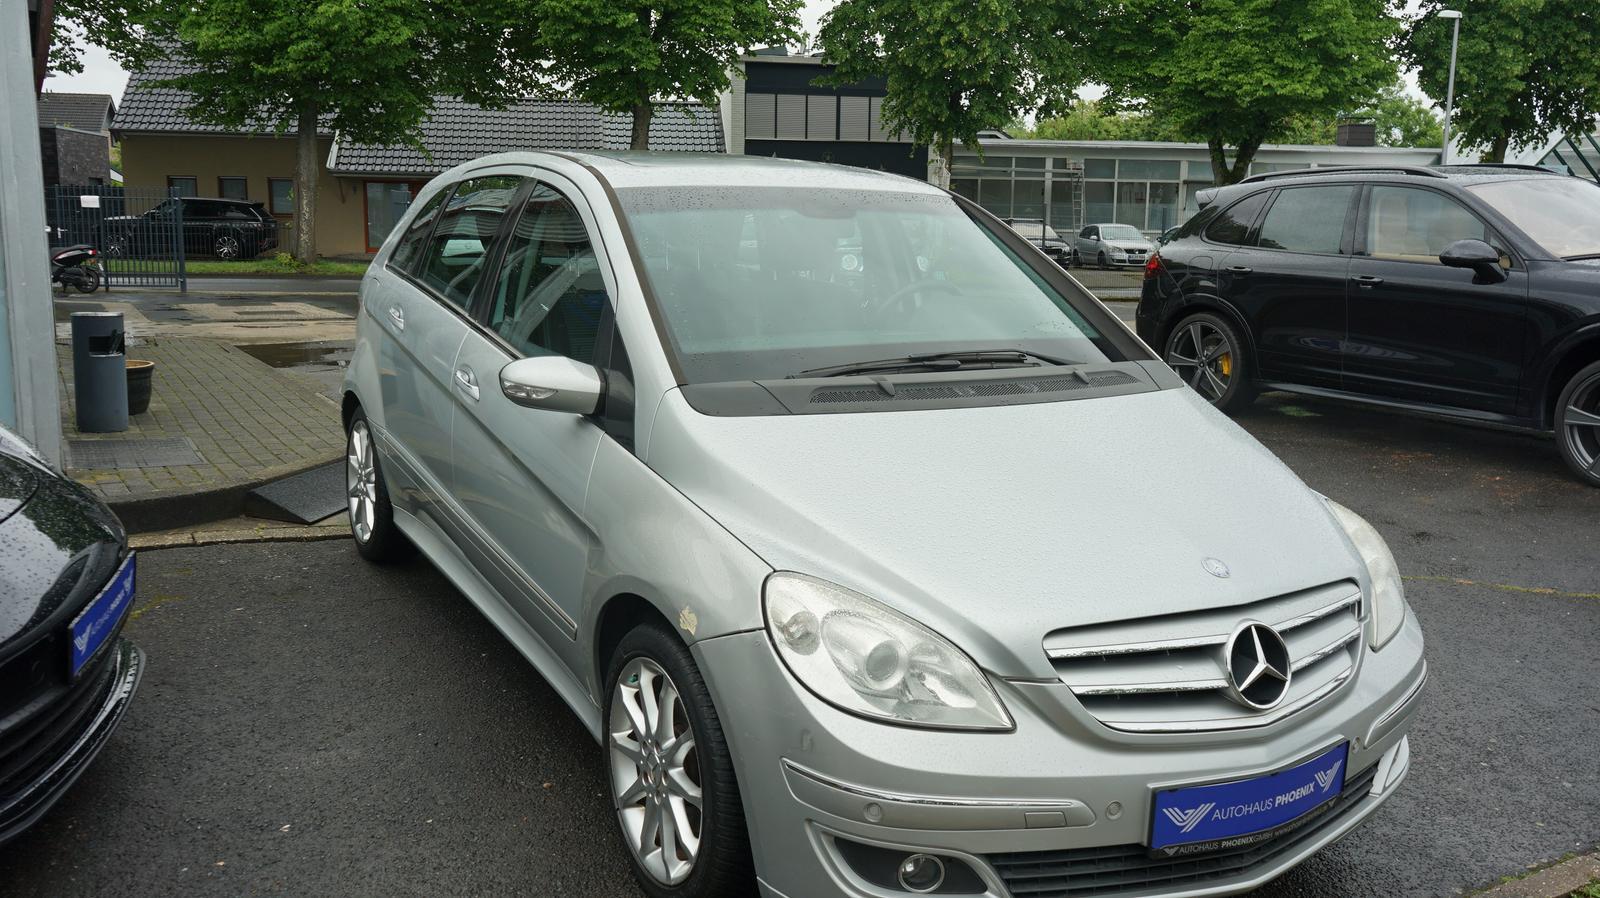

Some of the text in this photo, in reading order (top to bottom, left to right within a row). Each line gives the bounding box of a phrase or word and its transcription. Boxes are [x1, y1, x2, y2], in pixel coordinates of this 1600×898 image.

[1211, 798, 1273, 821] AUTOHAUS
[1274, 781, 1315, 808] PHOENIX
[1179, 841, 1219, 855] AUTOHAUS
